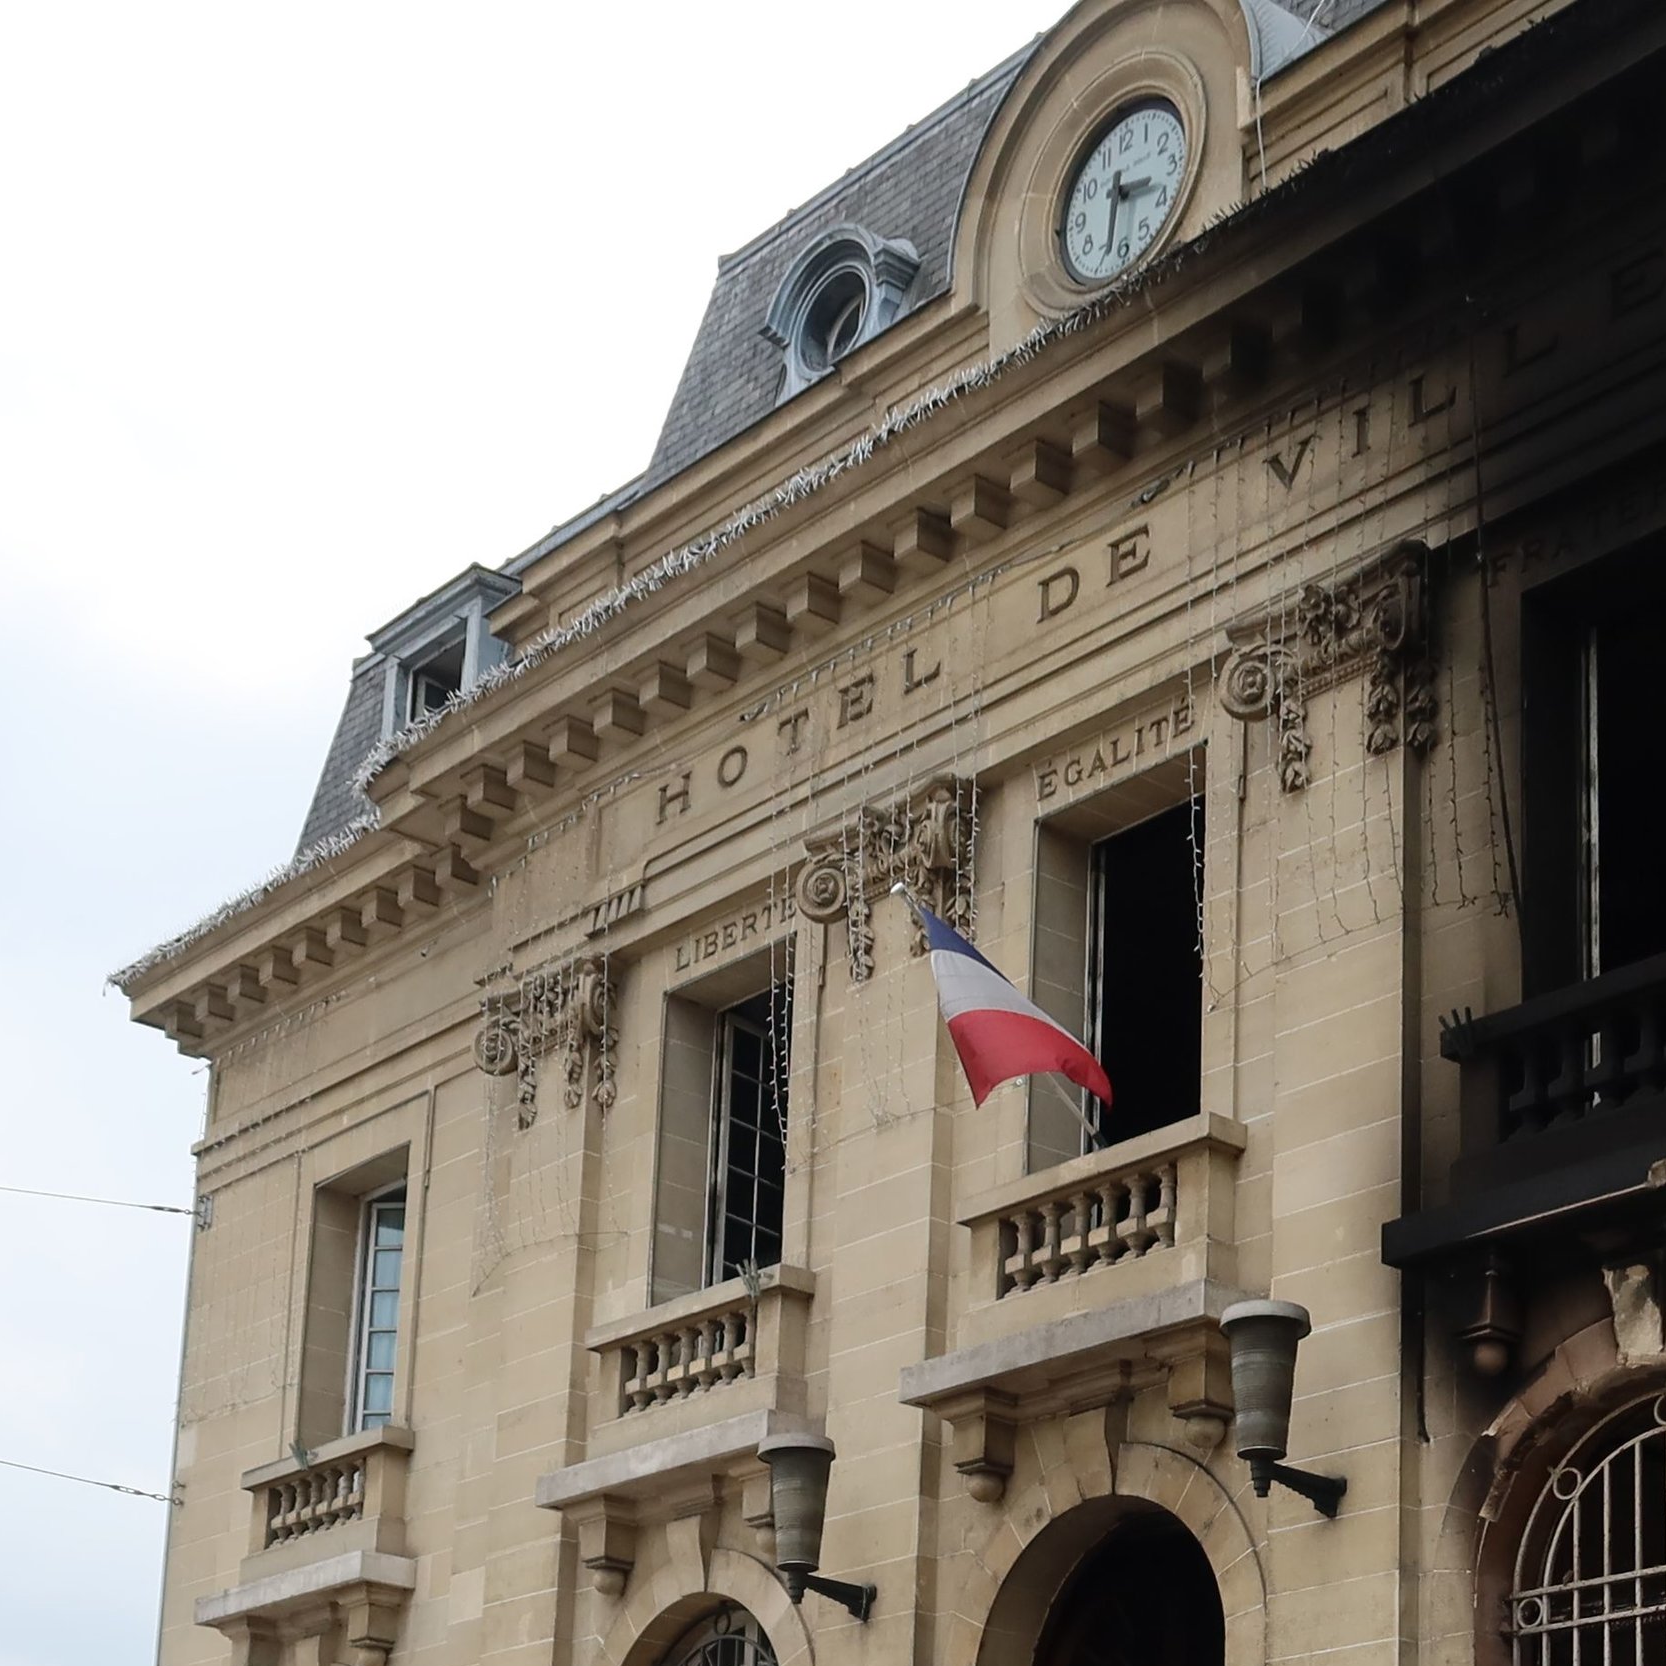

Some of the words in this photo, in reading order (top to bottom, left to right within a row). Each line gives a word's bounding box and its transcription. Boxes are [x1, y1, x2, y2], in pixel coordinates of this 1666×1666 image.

[1119, 128, 1133, 154] 12
[1157, 131, 1170, 155] 2
[1102, 147, 1111, 171] 11
[1166, 153, 1178, 176] 3
[1083, 178, 1098, 203] 10
[1155, 185, 1168, 209] 4
[1075, 213, 1086, 234] 9
[1137, 217, 1150, 242] 5
[1083, 234, 1093, 255] 8
[1117, 236, 1130, 259] 6
[1036, 523, 1151, 624] DE
[1037, 696, 1197, 801] ÉGALITÉ
